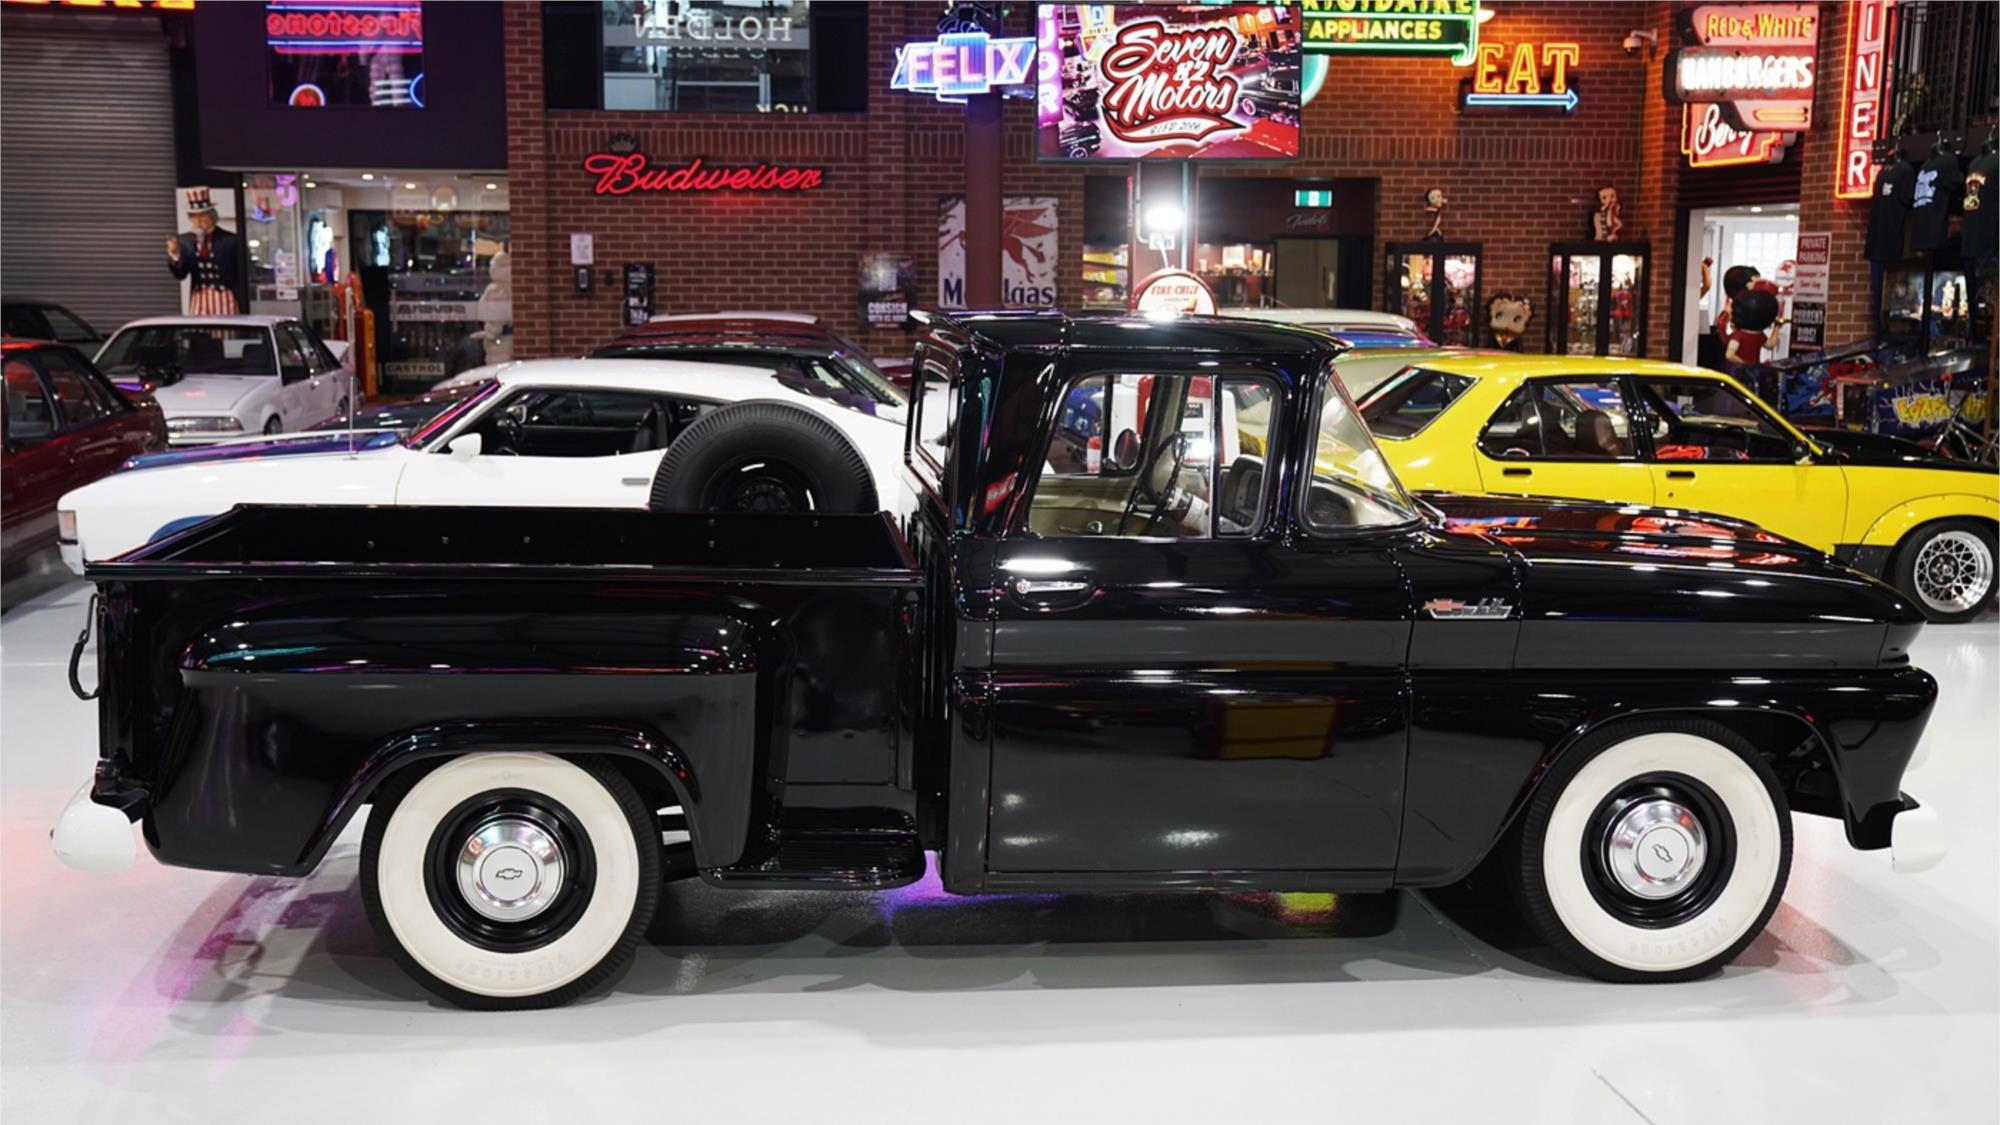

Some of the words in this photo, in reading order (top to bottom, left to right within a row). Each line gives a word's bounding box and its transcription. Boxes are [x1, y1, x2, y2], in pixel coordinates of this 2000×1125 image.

[1308, 20, 1442, 40] APPLIANCES
[1709, 15, 1738, 38] RED
[1758, 14, 1812, 38] WHITE
[908, 44, 1024, 86] FELIX
[1109, 26, 1230, 80] Seven
[1173, 61, 1209, 82] 82
[1475, 43, 1579, 93] EAT
[1681, 55, 1814, 90] HAMBURGERS
[1109, 73, 1232, 124] Motors
[583, 152, 822, 195] Budweiser
[387, 363, 441, 373] CASTROL
